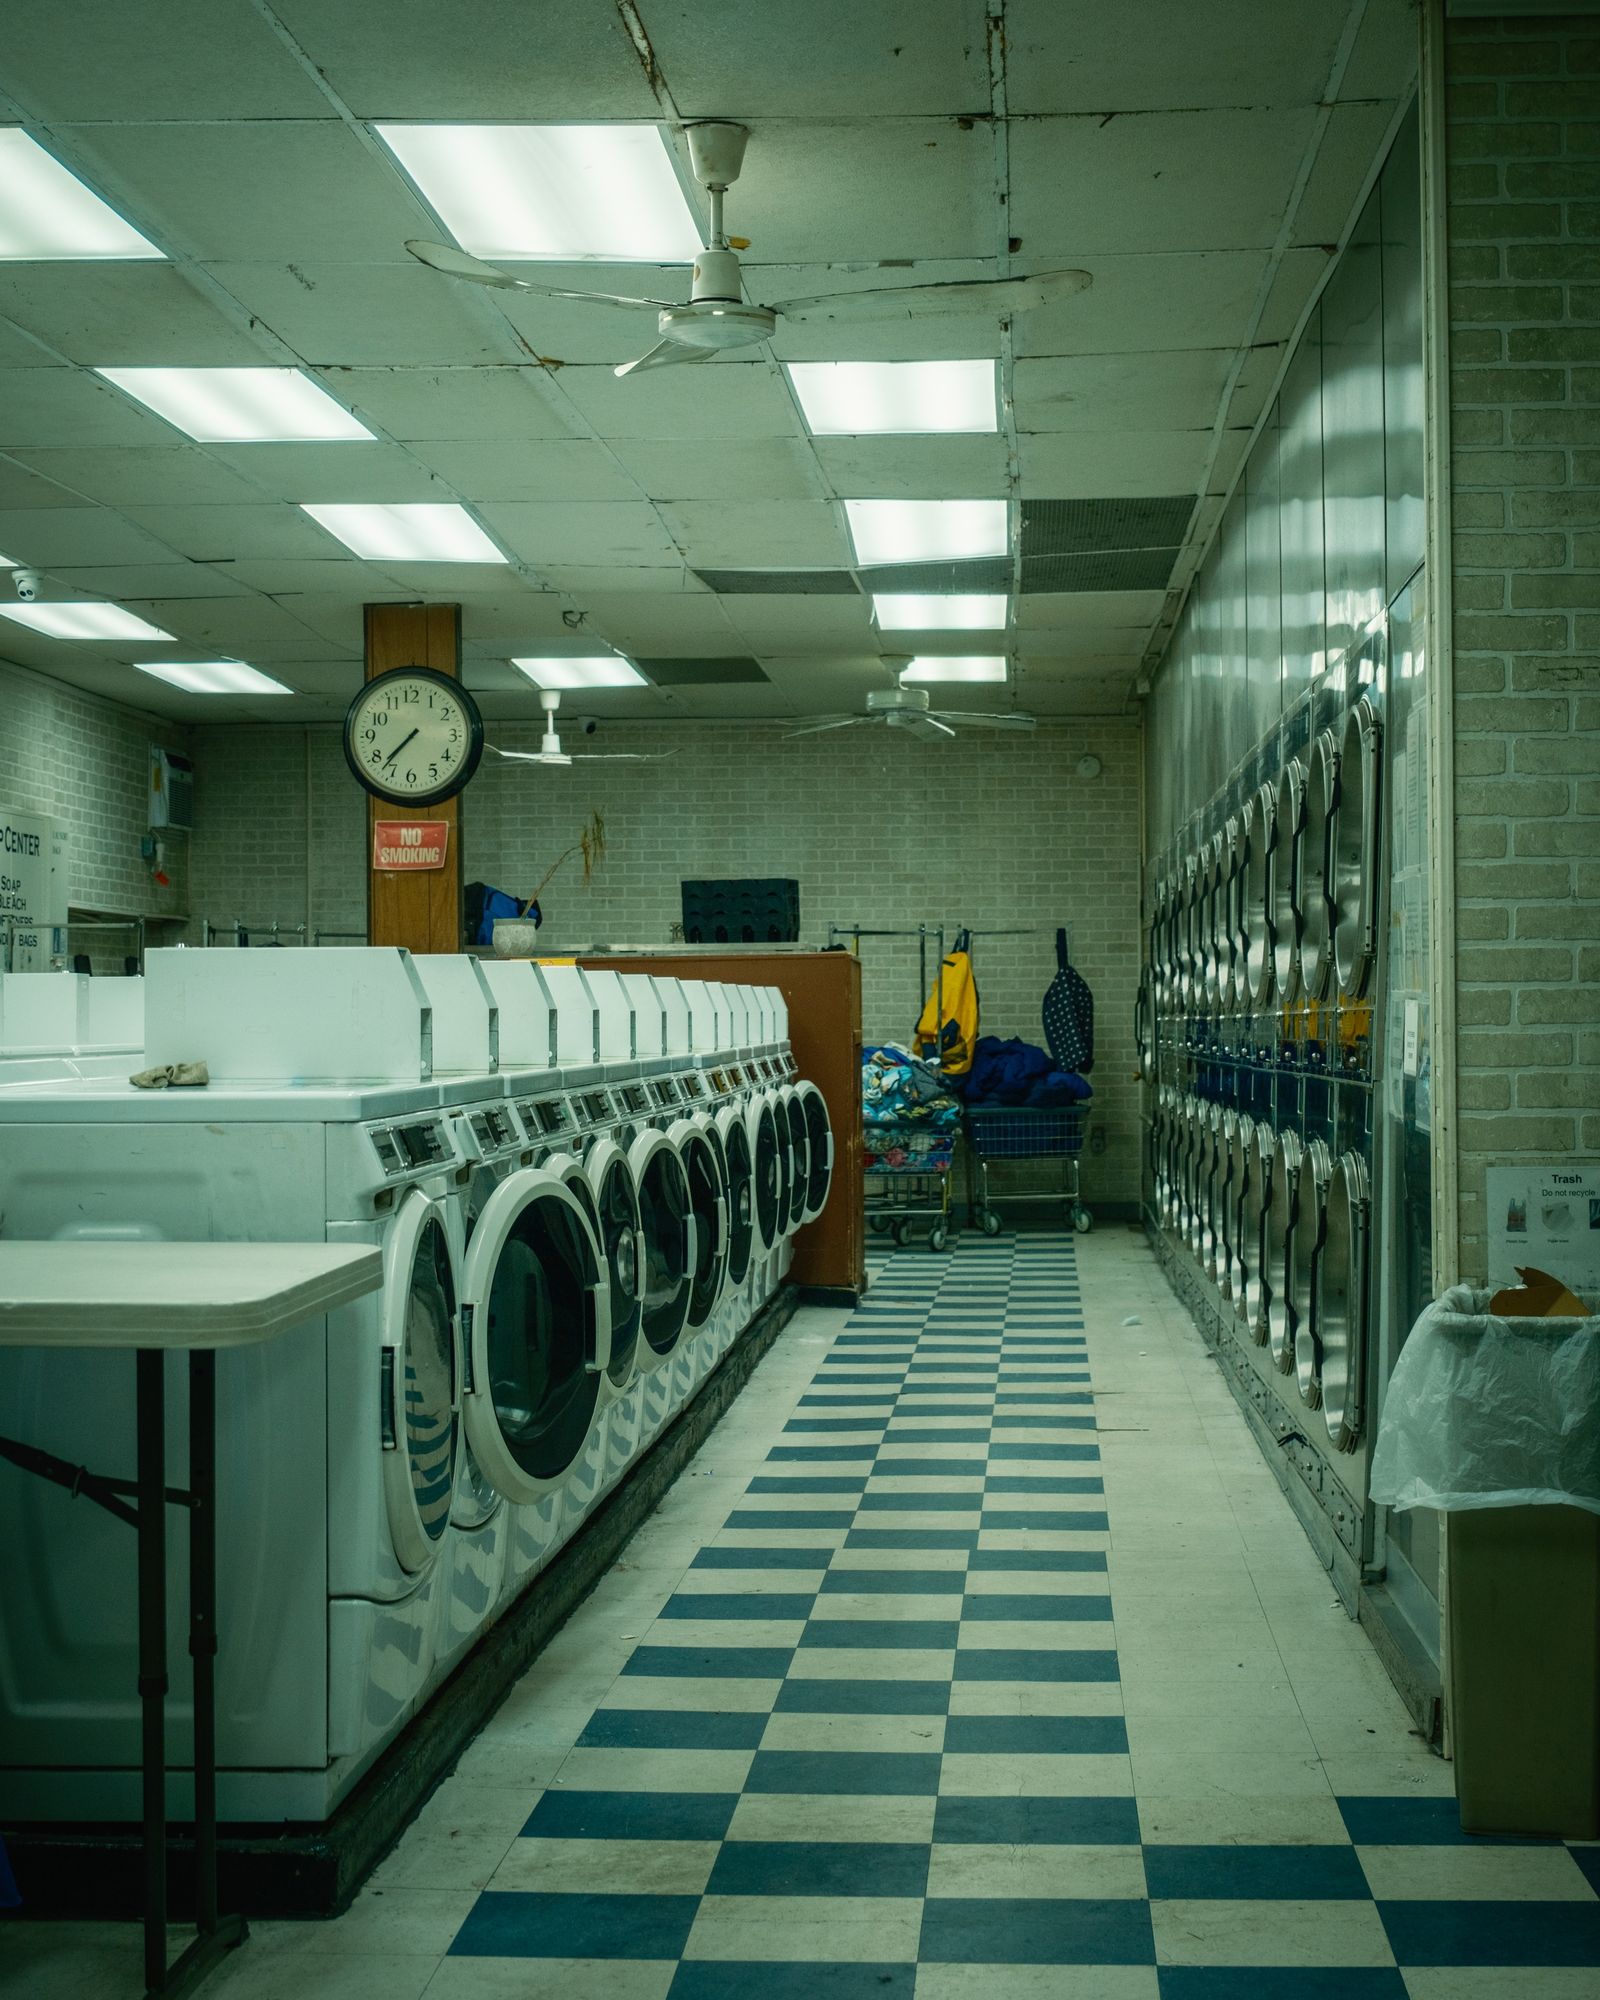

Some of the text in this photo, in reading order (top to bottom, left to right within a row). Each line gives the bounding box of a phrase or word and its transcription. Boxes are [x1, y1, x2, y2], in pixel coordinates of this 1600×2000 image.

[387, 696, 398, 709] 11
[404, 690, 419, 703] 12
[429, 695, 432, 708] 1
[373, 712, 388, 726] 10
[440, 708, 449, 721] 2
[366, 729, 375, 744] 9
[449, 729, 457, 742] 3
[372, 749, 382, 763] 8
[441, 748, 451, 761] 4
[389, 764, 397, 777] 7
[406, 768, 416, 783] 6
[428, 763, 437, 777] 5
[5, 826, 40, 856] CENTER
[401, 828, 421, 846] NO
[381, 847, 439, 863] SMOKING
[1, 875, 21, 892] SOAP
[19, 934, 38, 947] BAGS
[1552, 1174, 1582, 1184] Trash
[1542, 1189, 1596, 1198] Do not recycle
